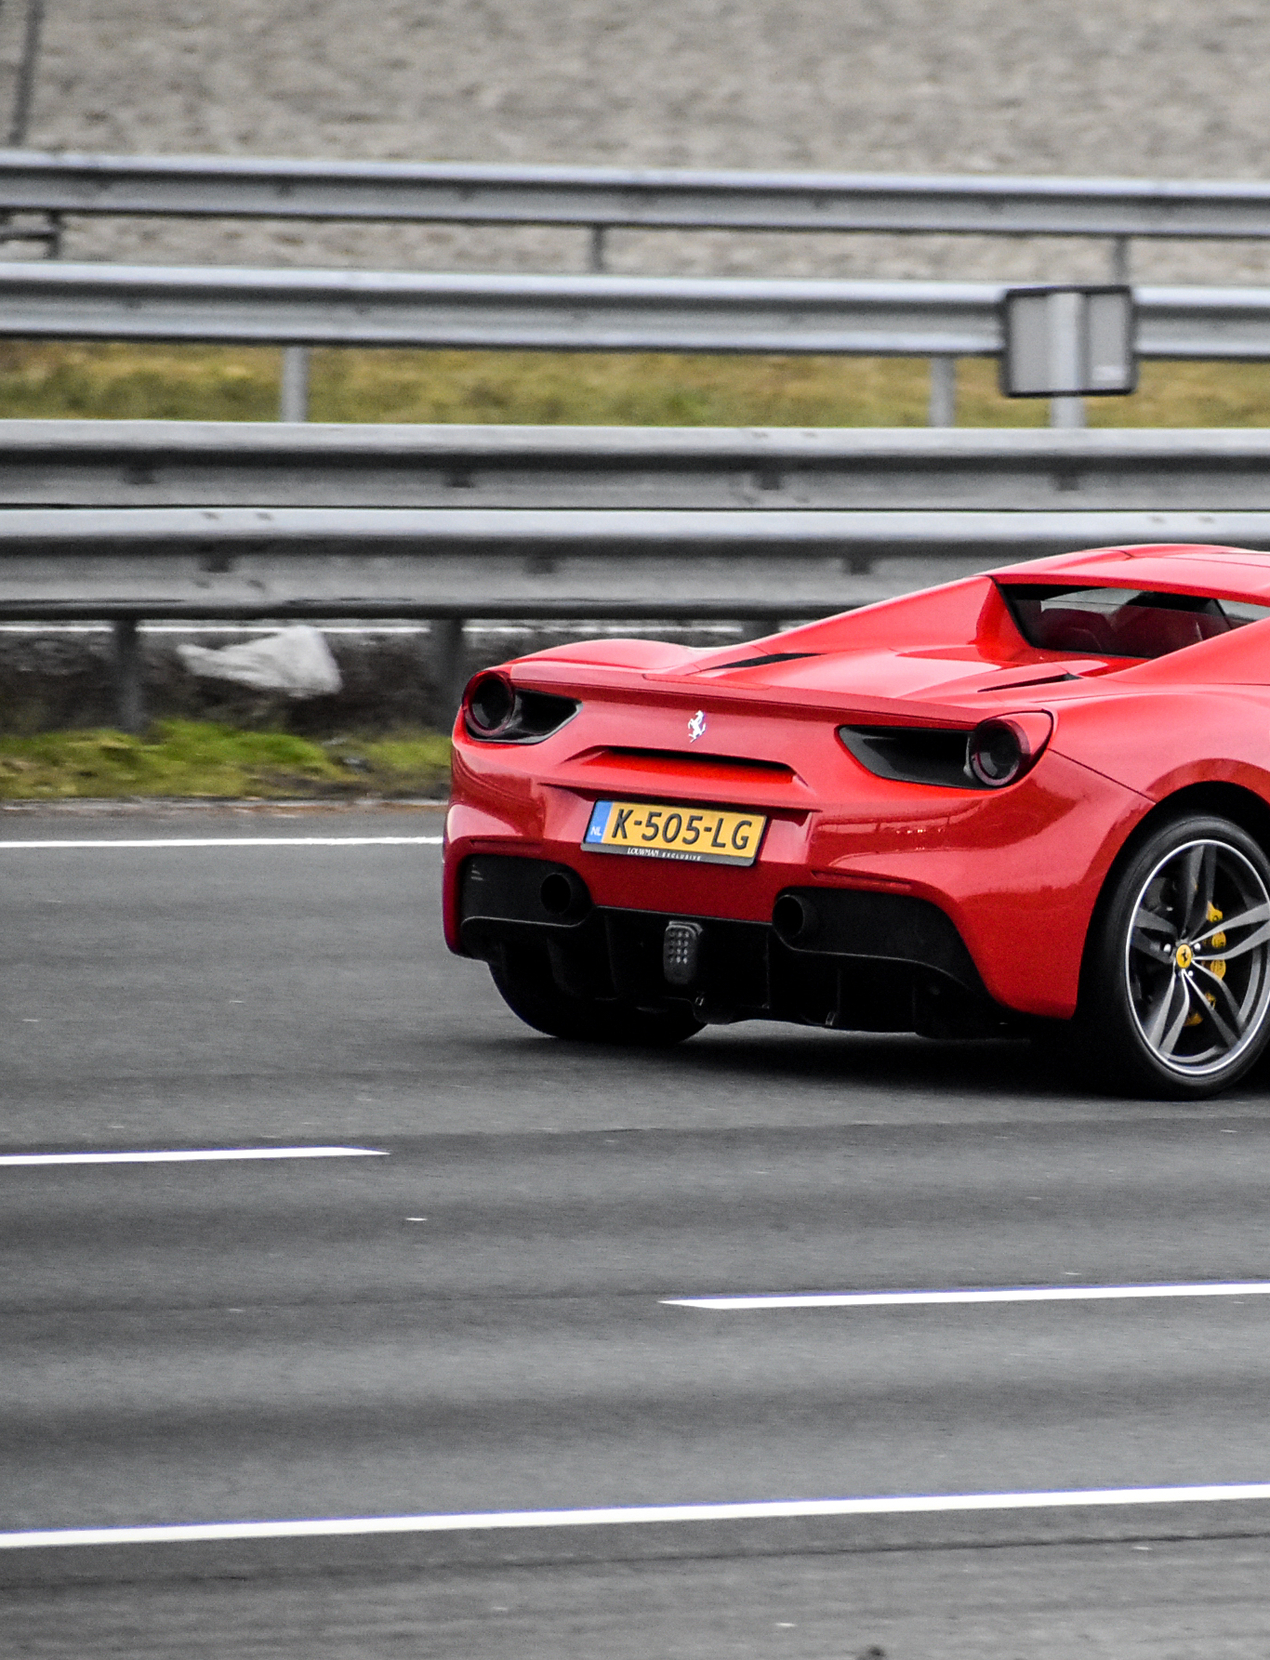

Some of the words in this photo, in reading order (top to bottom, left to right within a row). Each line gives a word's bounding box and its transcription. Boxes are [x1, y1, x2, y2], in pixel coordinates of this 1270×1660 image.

[590, 826, 603, 837] NL
[611, 808, 753, 850] K-505-LG
[627, 847, 660, 857] LOUWMAN
[661, 852, 703, 862] EXCLUSIVE
